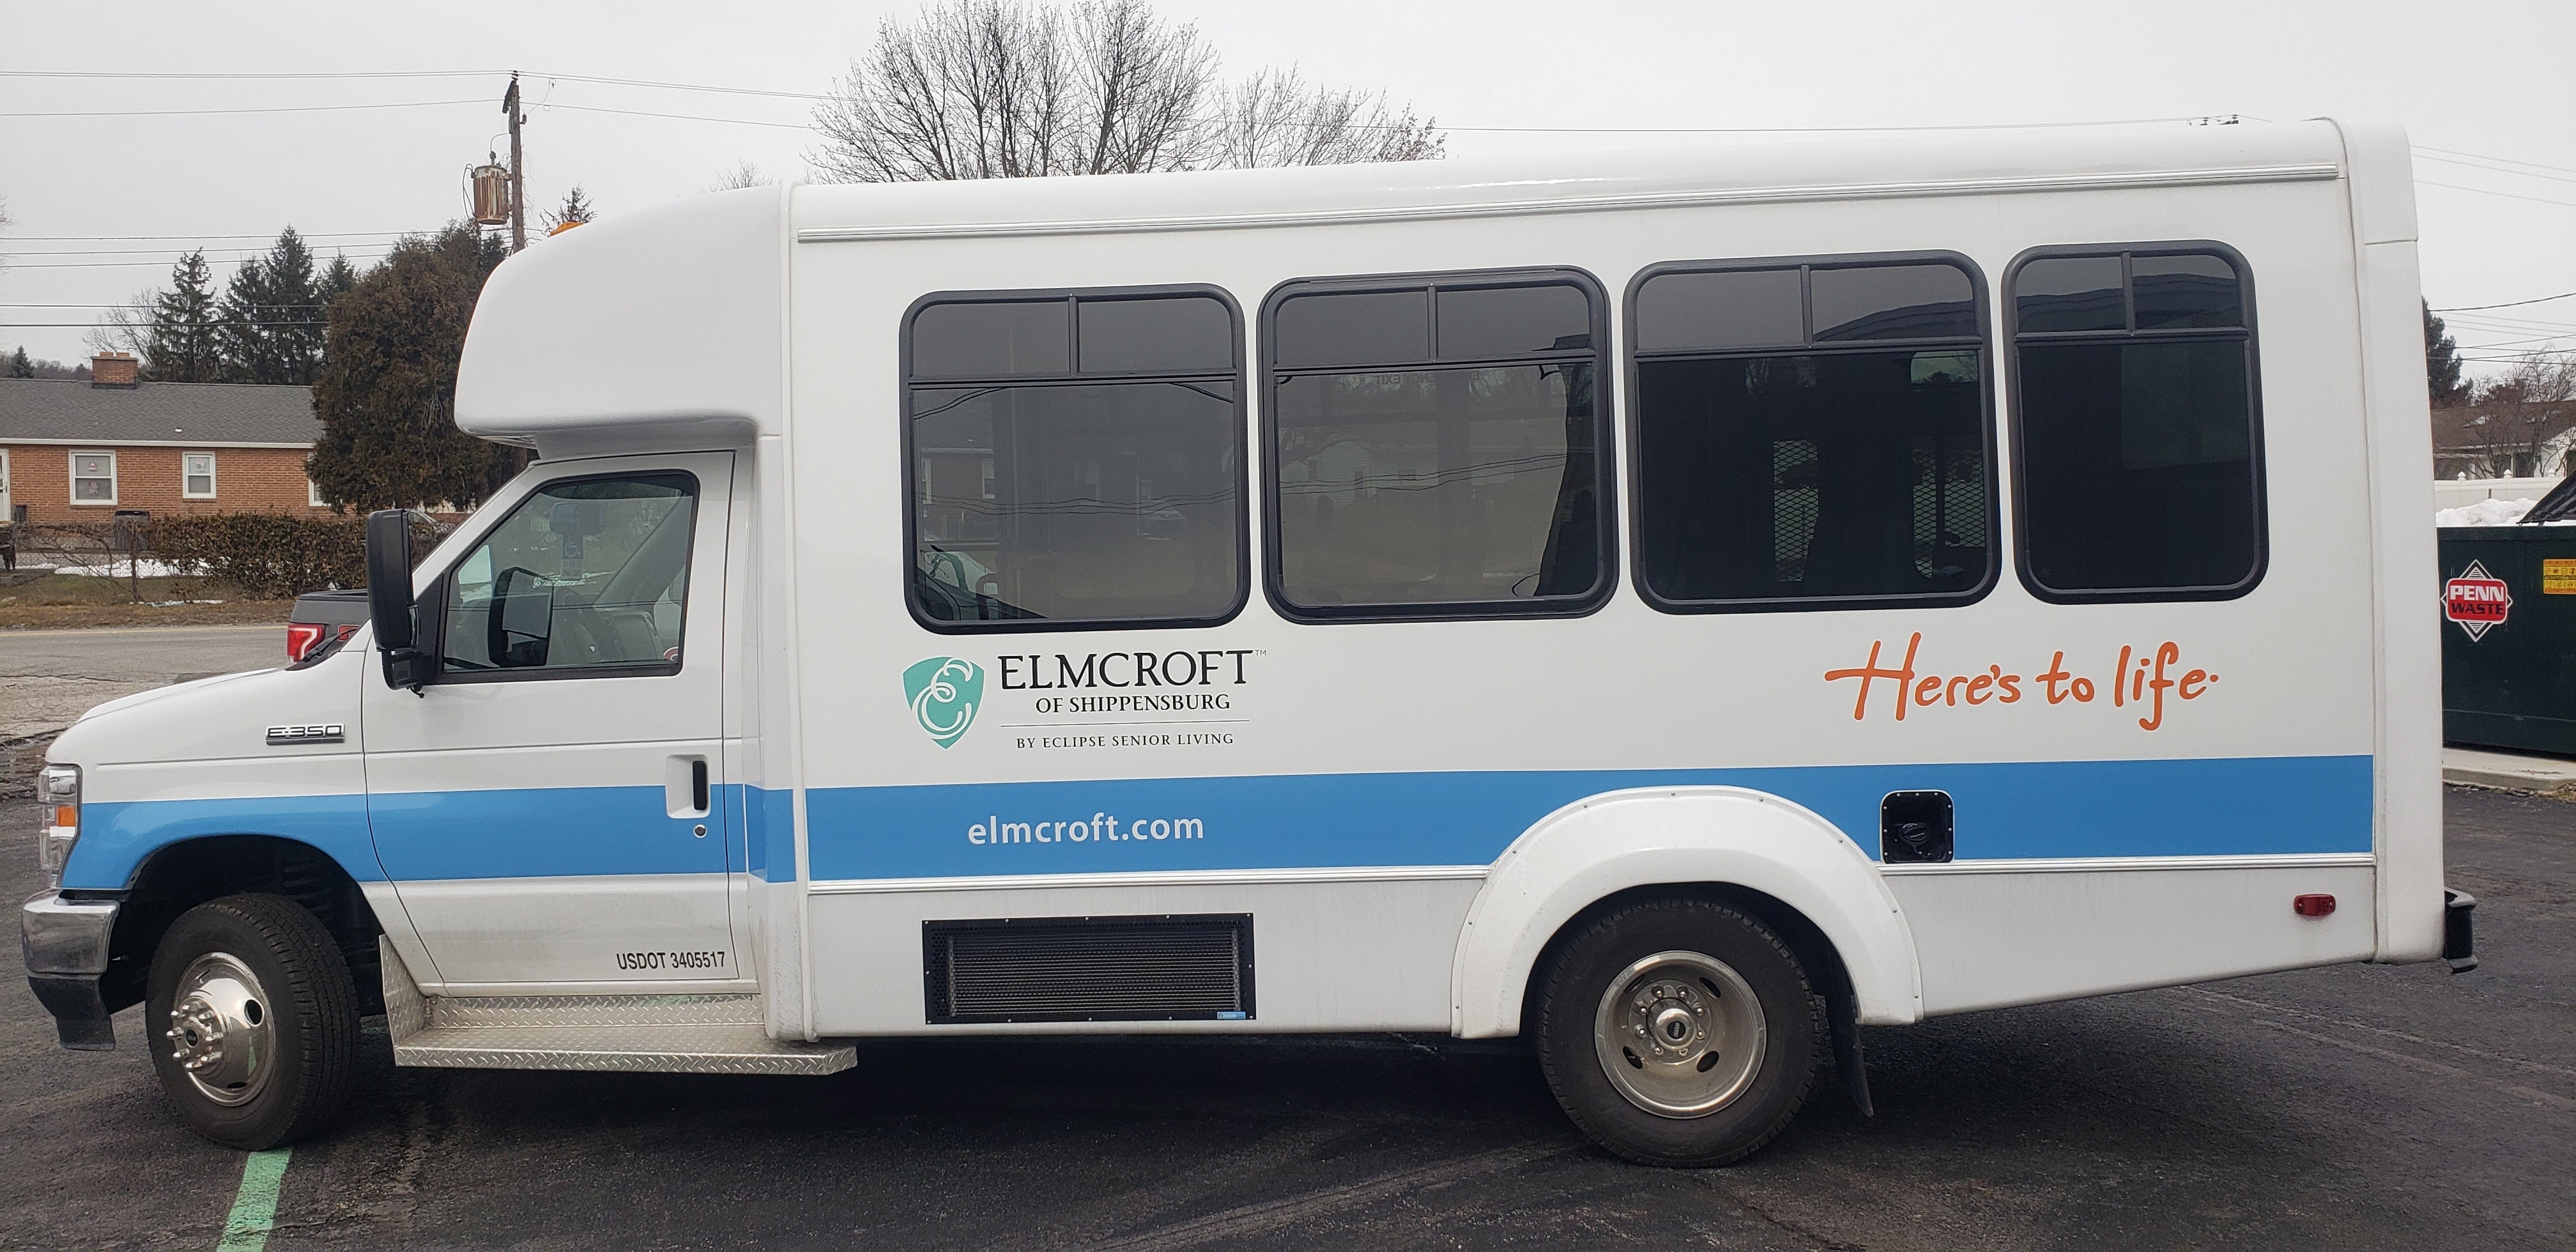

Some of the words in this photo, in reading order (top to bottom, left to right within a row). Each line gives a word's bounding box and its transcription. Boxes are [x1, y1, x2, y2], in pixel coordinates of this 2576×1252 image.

[2450, 585, 2504, 602] PENN
[2451, 602, 2504, 615] WASTE
[997, 650, 1254, 690] ELMCROFT
[1824, 632, 2021, 721] Here's
[2035, 651, 2095, 704] to
[1036, 698, 1063, 714] OF
[1070, 694, 1230, 713] SHIPPENSBURG
[1016, 737, 1036, 749] BY
[1043, 736, 1106, 748] ECLIPSE
[1112, 735, 1171, 747] SENIOR
[1177, 733, 1234, 745] LIVING
[968, 812, 1204, 844] elmcroft.com
[616, 952, 666, 970] USDOT
[670, 950, 725, 969] 3405517
